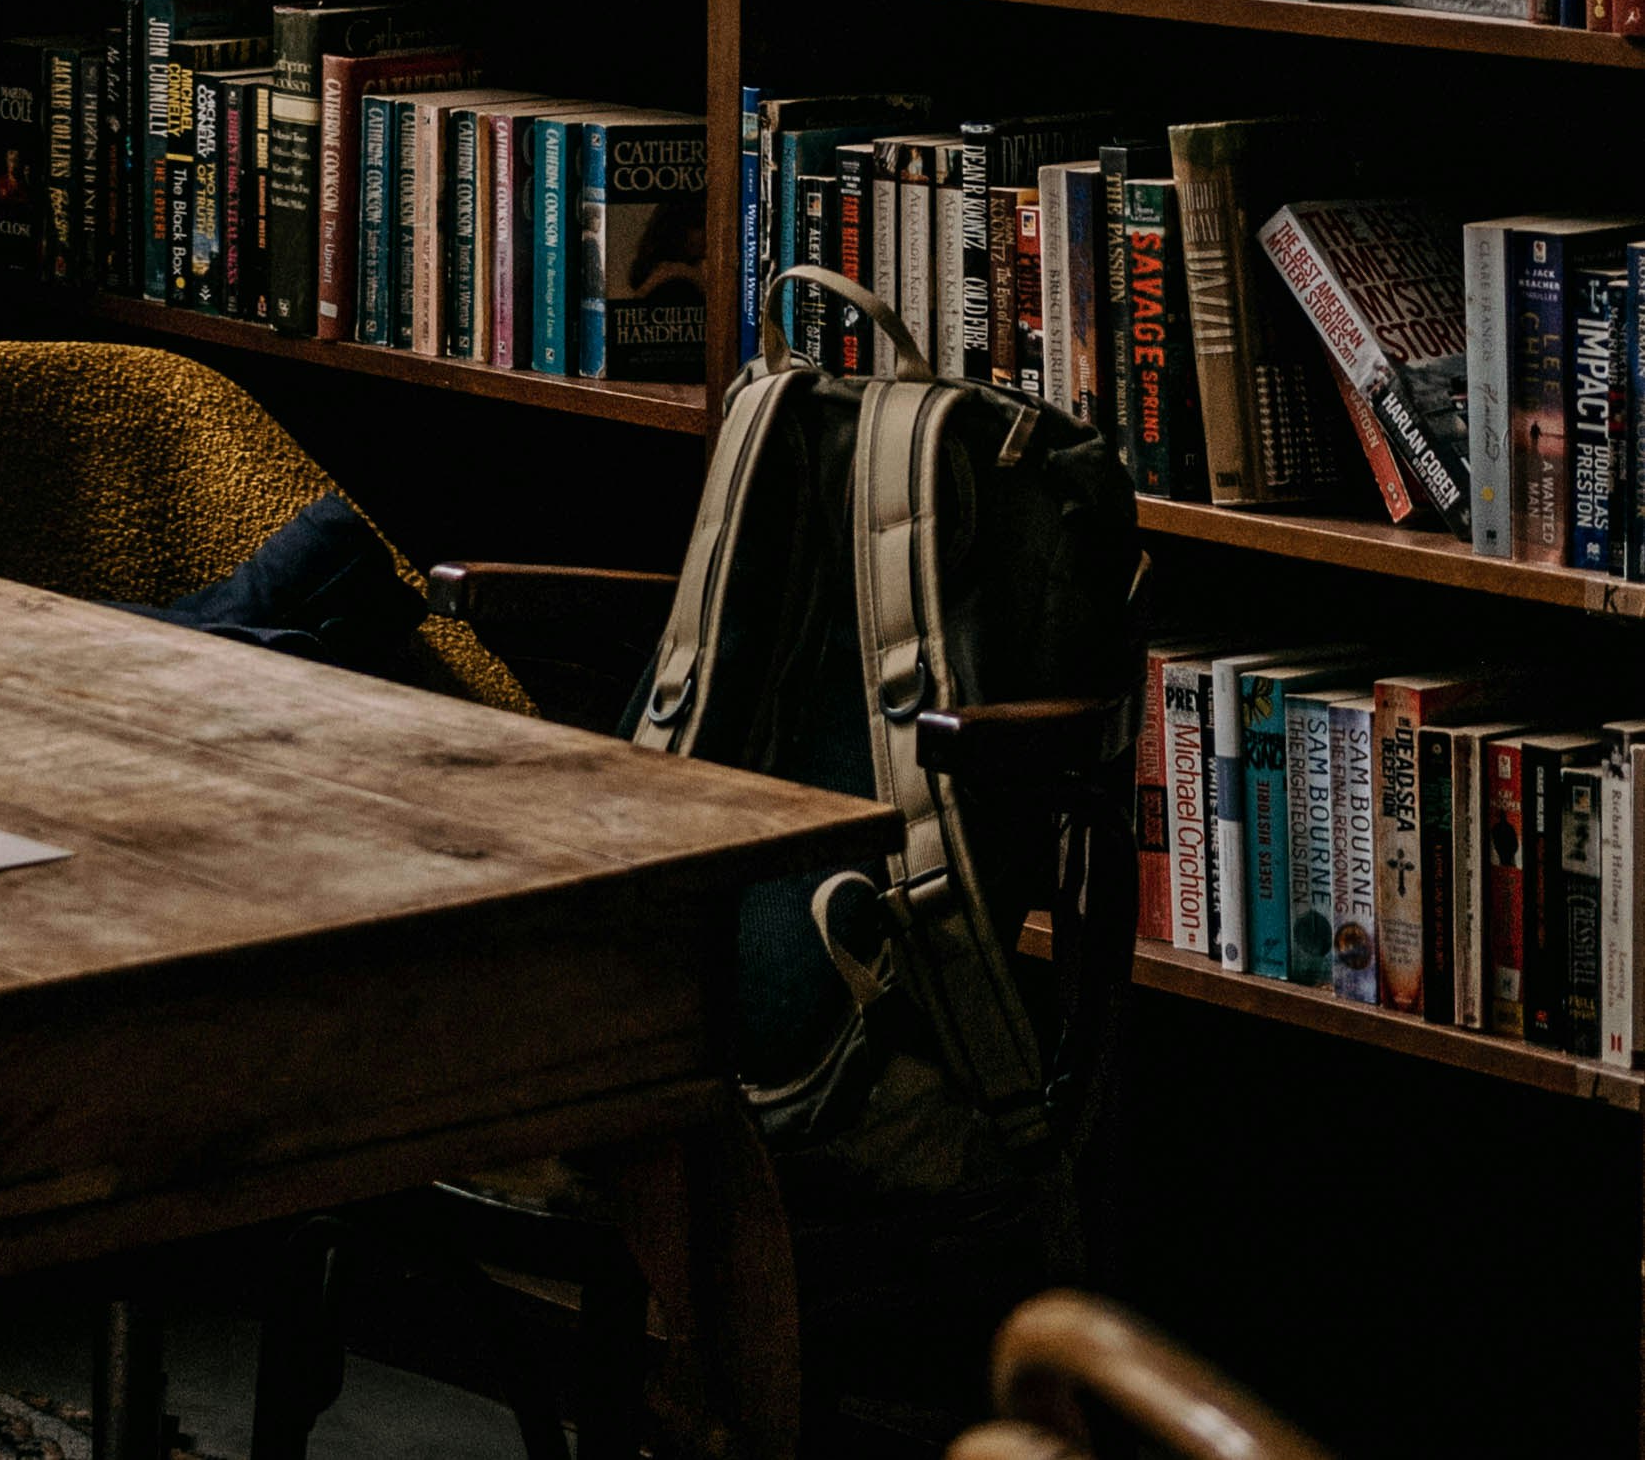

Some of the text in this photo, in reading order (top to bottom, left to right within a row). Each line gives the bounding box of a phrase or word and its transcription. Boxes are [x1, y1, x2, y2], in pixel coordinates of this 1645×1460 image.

[167, 63, 181, 138] CONNELLY
[181, 68, 193, 134] MICHAEL
[196, 84, 208, 158] CONNELLY
[205, 88, 215, 155] MICHAEL
[322, 78, 341, 213] CATHERINE COOKSON
[173, 168, 187, 276] The Black Box
[964, 277, 988, 351] COLD FIRE
[1266, 234, 1359, 369] MYSTERY STORIES 2011
[1274, 221, 1365, 349] THE BEST AMERICAN
[1131, 232, 1165, 444] SAVAGE SPRING
[1576, 318, 1609, 434] IMPACT
[1381, 392, 1461, 505] HARLAN COBEN
[1576, 443, 1592, 528] PRESTON
[1593, 445, 1608, 530] DOUGLAS
[1527, 482, 1539, 519] MAN
[1542, 460, 1554, 544] A WANTED
[1603, 583, 1618, 613] K
[1174, 723, 1205, 929] Michael Crichton
[1307, 719, 1330, 905] SAM BOURNE
[1349, 729, 1371, 917] SAM BOURNE
